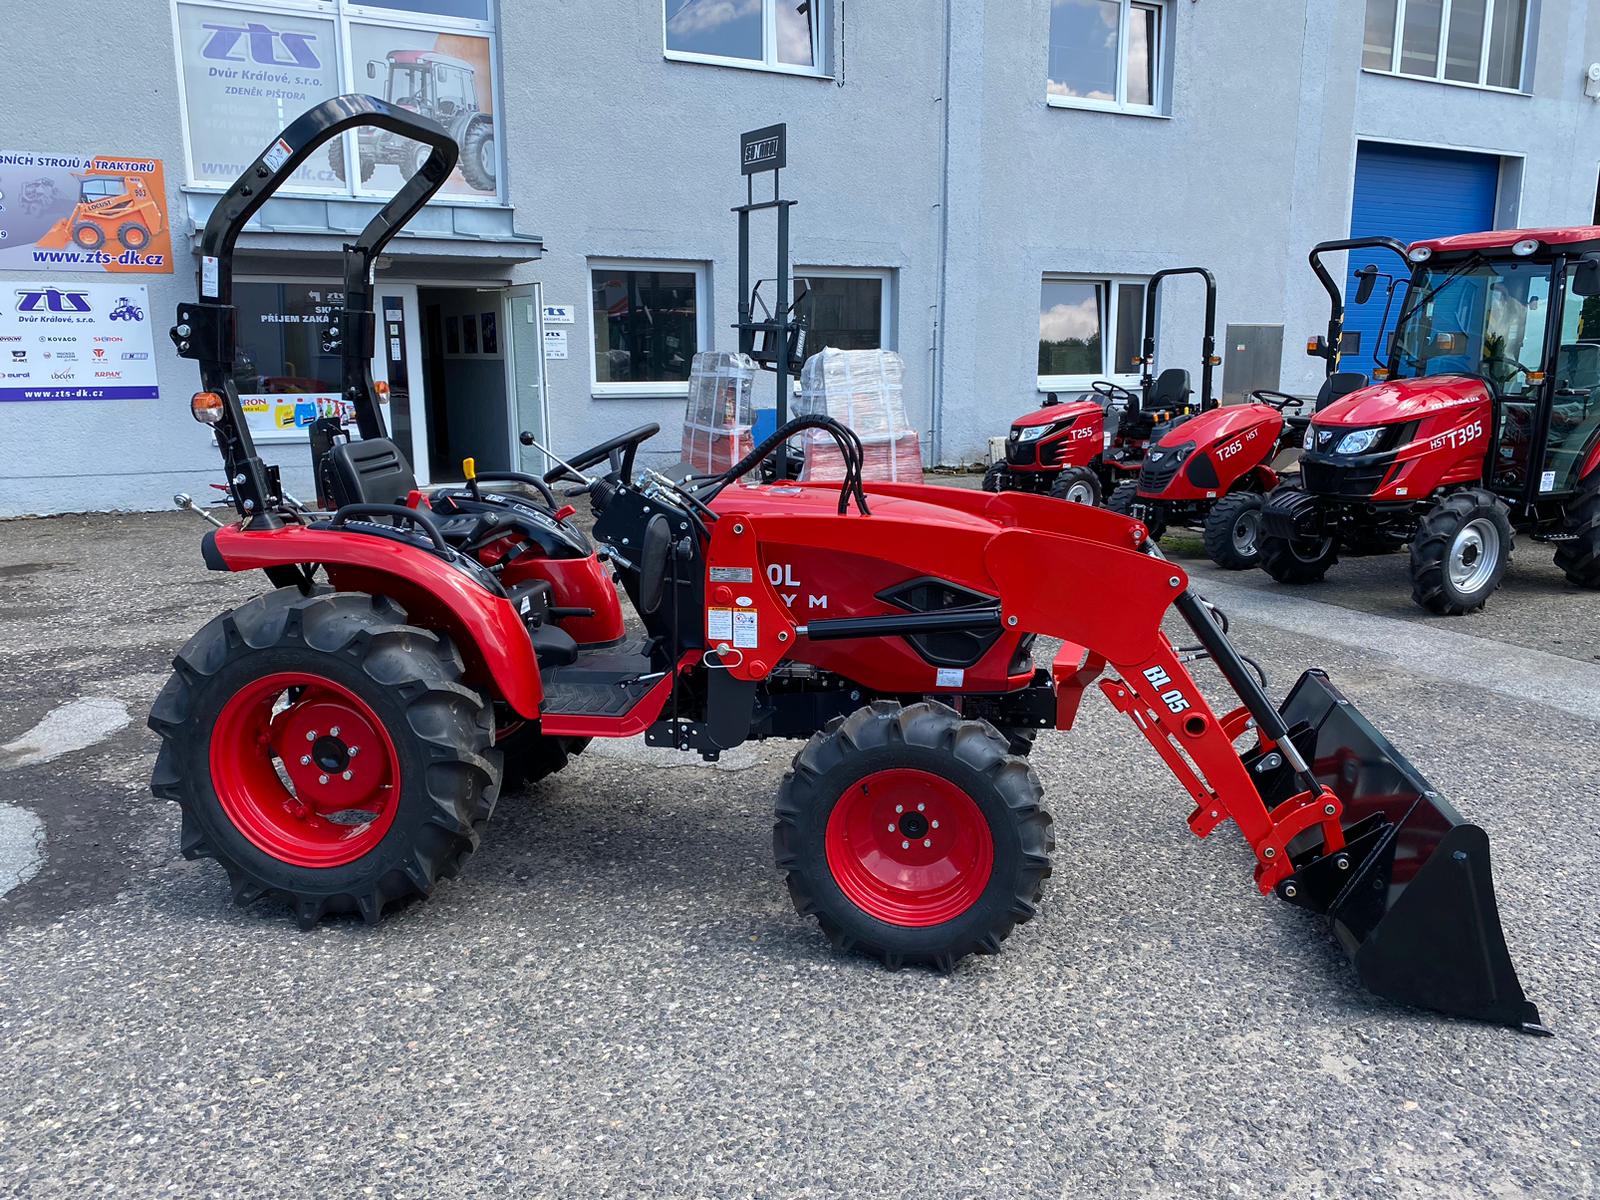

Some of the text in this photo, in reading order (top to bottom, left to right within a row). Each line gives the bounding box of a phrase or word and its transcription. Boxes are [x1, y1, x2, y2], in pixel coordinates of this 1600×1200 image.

[202, 23, 321, 69] zts
[208, 67, 323, 87] Dvůr Králové, s.r.o.
[225, 86, 306, 101] ZDENĚK PIŠTORA
[37, 157, 80, 168] STROJŮ
[83, 160, 91, 168] A
[95, 161, 155, 172] TRAKTORŮ
[88, 200, 112, 211] LOCUST
[32, 251, 164, 265] www.zts-dk.cz
[17, 289, 92, 312] zts
[18, 315, 38, 323] Dvůr
[40, 316, 74, 324] Králové,
[261, 313, 300, 323] PŘÍJEM
[24, 389, 104, 398] www.zts-dk.cz
[1070, 426, 1093, 440] T255
[1430, 420, 1483, 450] HST T395
[1215, 428, 1259, 461] T265 HST
[1142, 664, 1191, 714] BL 05
